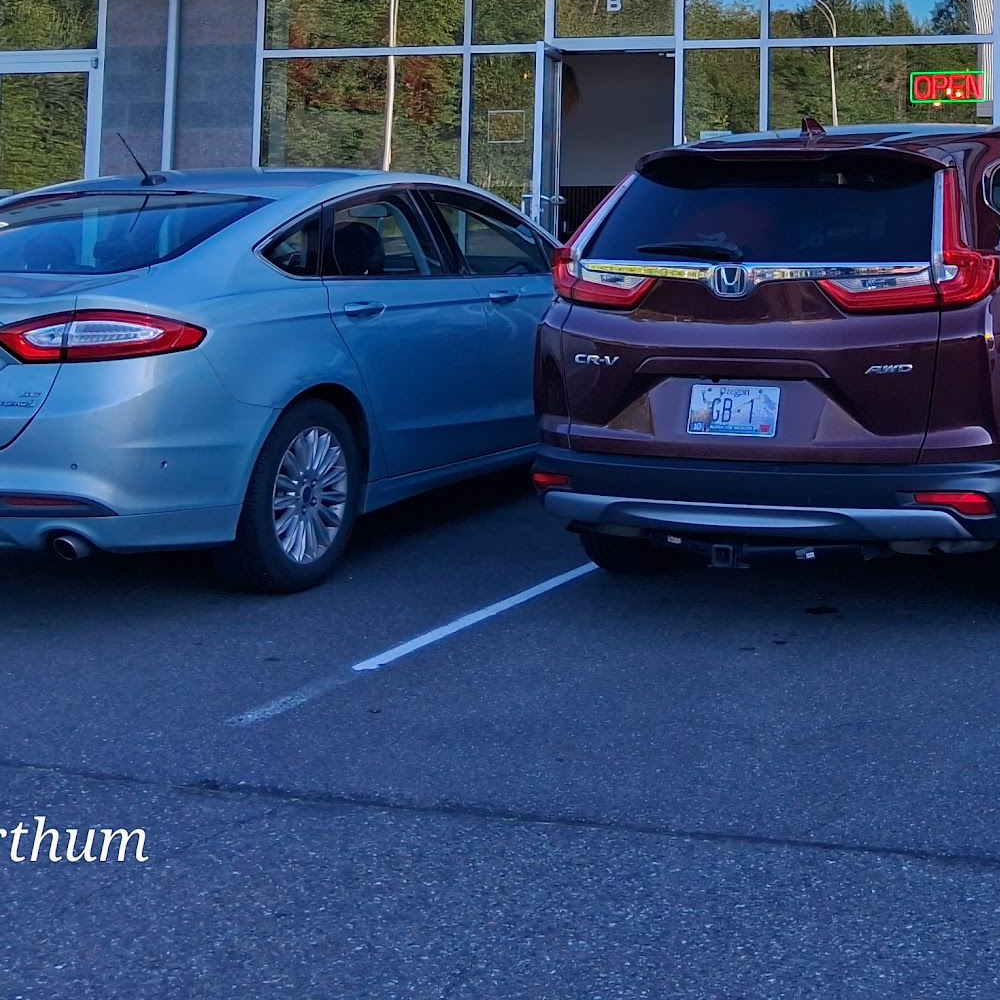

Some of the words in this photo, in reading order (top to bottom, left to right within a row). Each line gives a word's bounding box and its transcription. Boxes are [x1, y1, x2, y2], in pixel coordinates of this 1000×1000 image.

[913, 73, 984, 100] OPEN
[574, 353, 620, 367] CR-V
[864, 363, 913, 375] AWD
